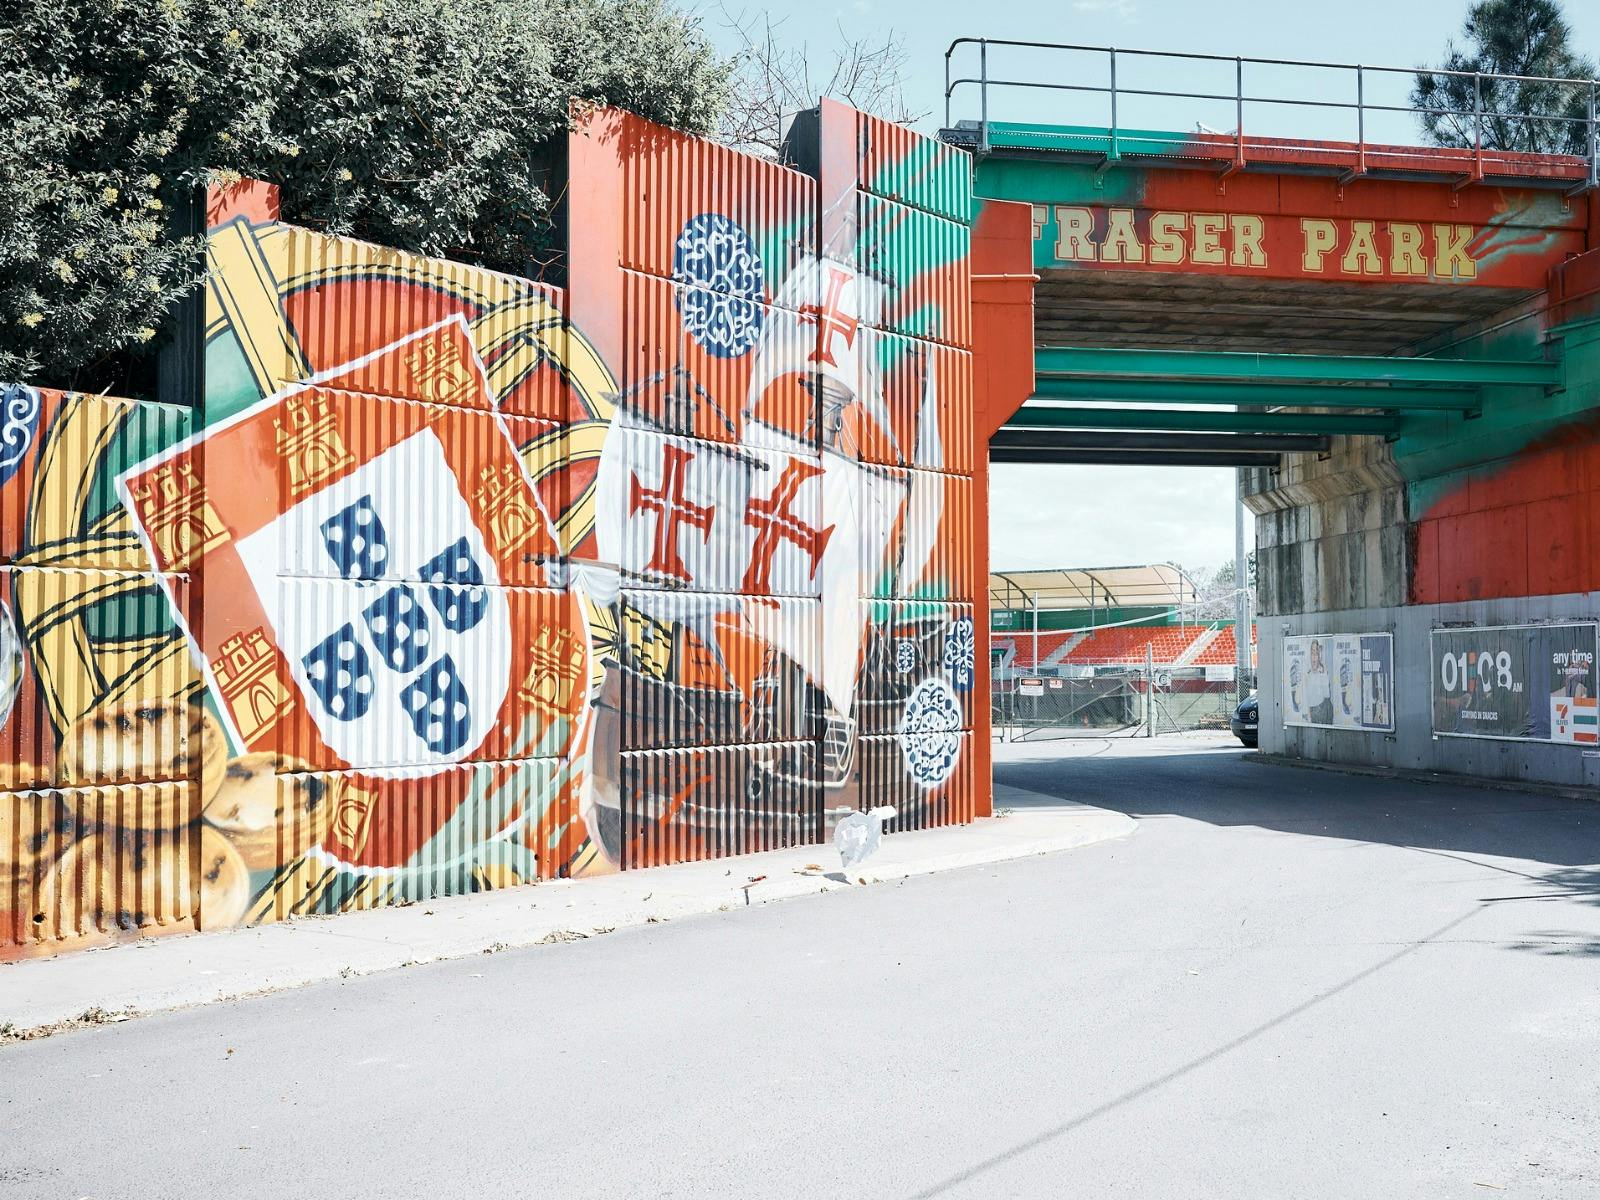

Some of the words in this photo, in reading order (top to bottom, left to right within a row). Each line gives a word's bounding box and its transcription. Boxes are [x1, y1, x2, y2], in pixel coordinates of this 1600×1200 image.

[1301, 218, 1478, 279] PARK
[1552, 652, 1570, 667] any
[1570, 649, 1593, 664] time
[1513, 682, 1523, 693] AM
